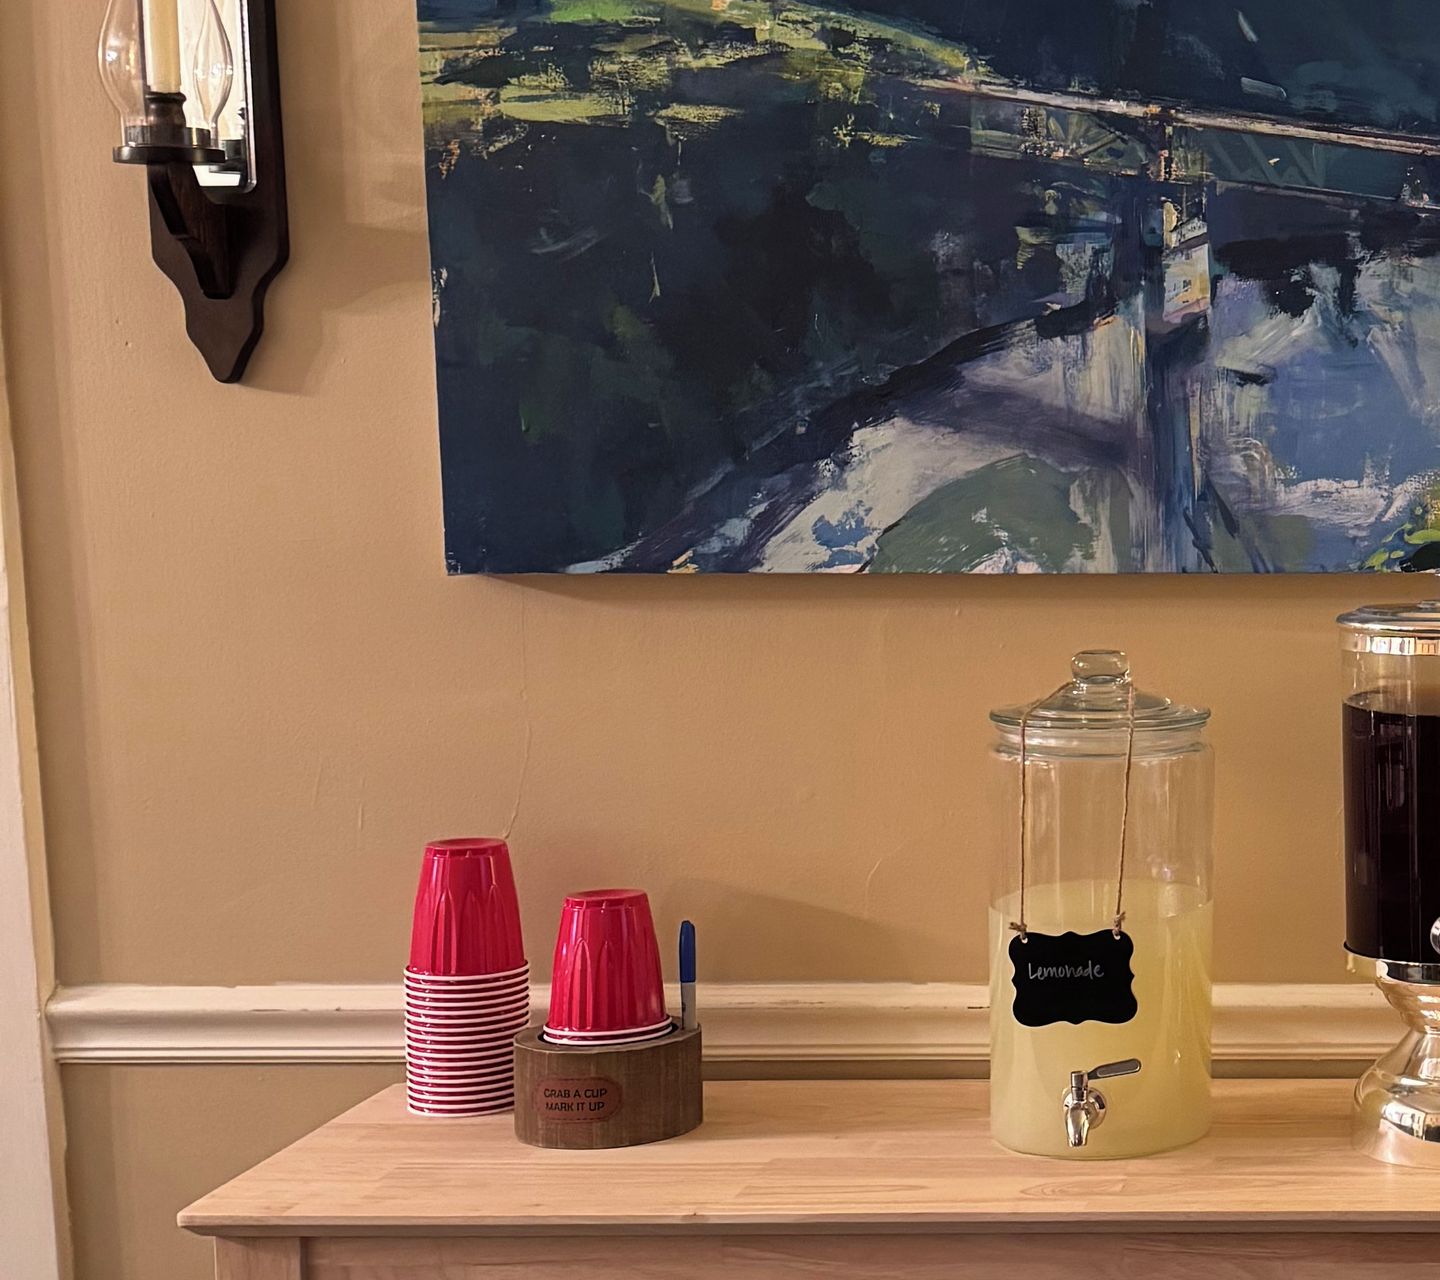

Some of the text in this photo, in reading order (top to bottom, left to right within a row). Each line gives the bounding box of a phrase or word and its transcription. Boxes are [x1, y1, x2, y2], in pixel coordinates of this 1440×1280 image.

[1028, 959, 1105, 980] Lemonade
[543, 1087, 608, 1099] GRAB A CUP
[545, 1101, 605, 1112] MARK IT UP
